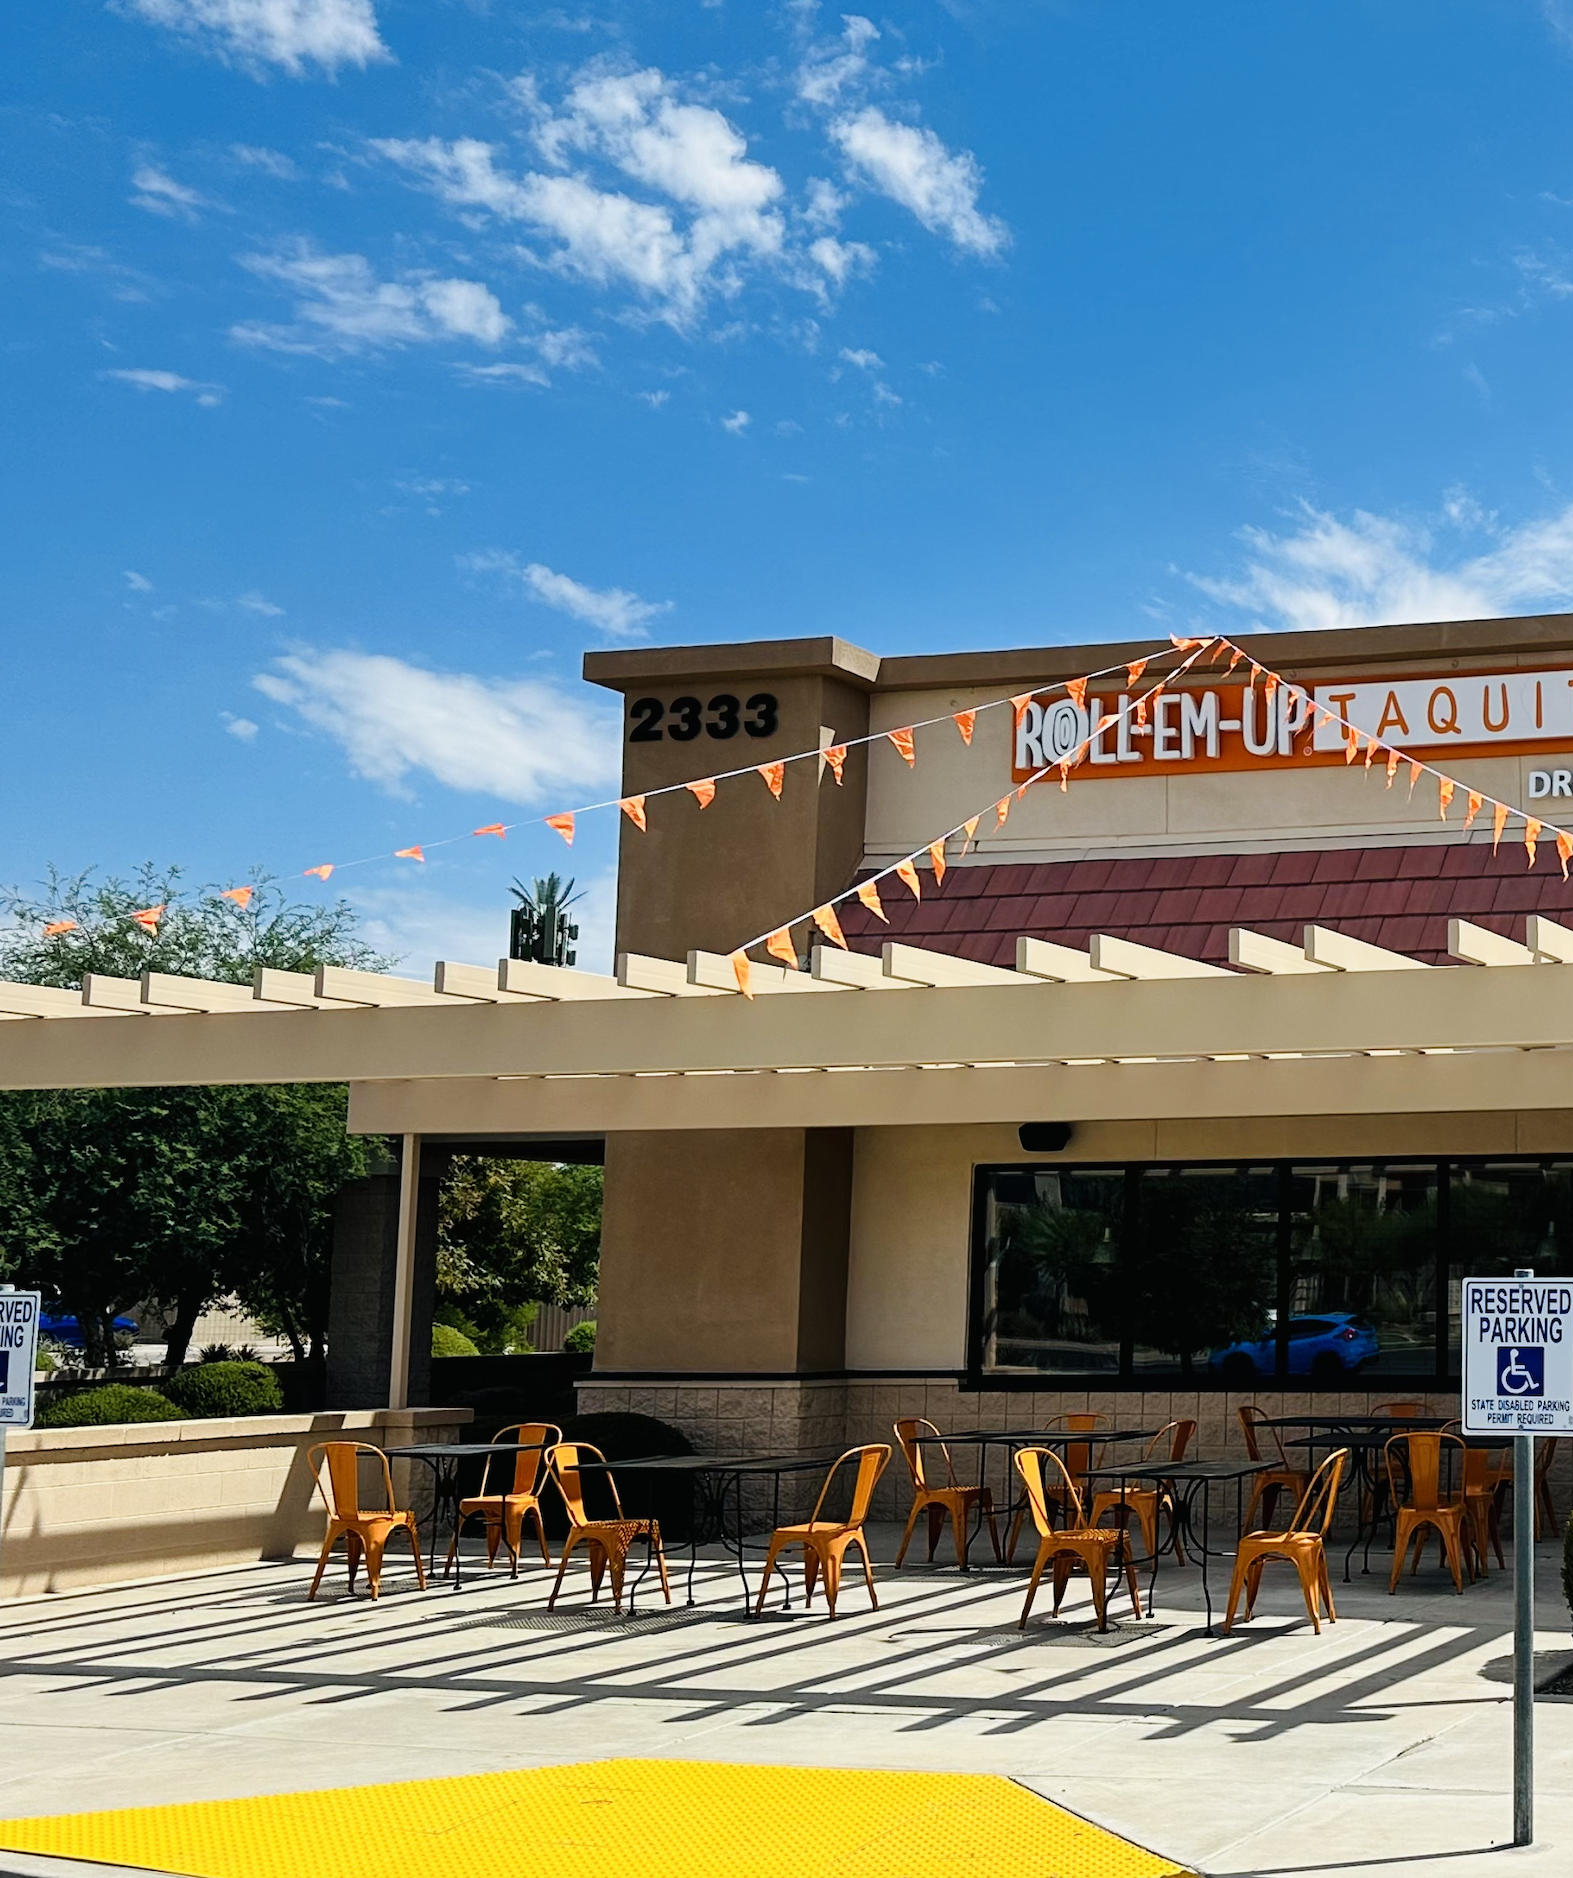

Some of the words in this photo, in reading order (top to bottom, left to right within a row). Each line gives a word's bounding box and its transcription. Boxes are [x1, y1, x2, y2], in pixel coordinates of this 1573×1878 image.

[629, 693, 779, 743] 2333
[1015, 685, 1309, 770] ROLL-EM-UP
[1471, 1288, 1572, 1315] RESERVED
[1479, 1317, 1563, 1343] PARKING
[1471, 1399, 1494, 1410] STATE
[1498, 1400, 1534, 1411] DISABLED
[1537, 1400, 1570, 1412] PARKING
[1487, 1412, 1514, 1424] PERMIT
[1517, 1413, 1554, 1425] REQUIRED
